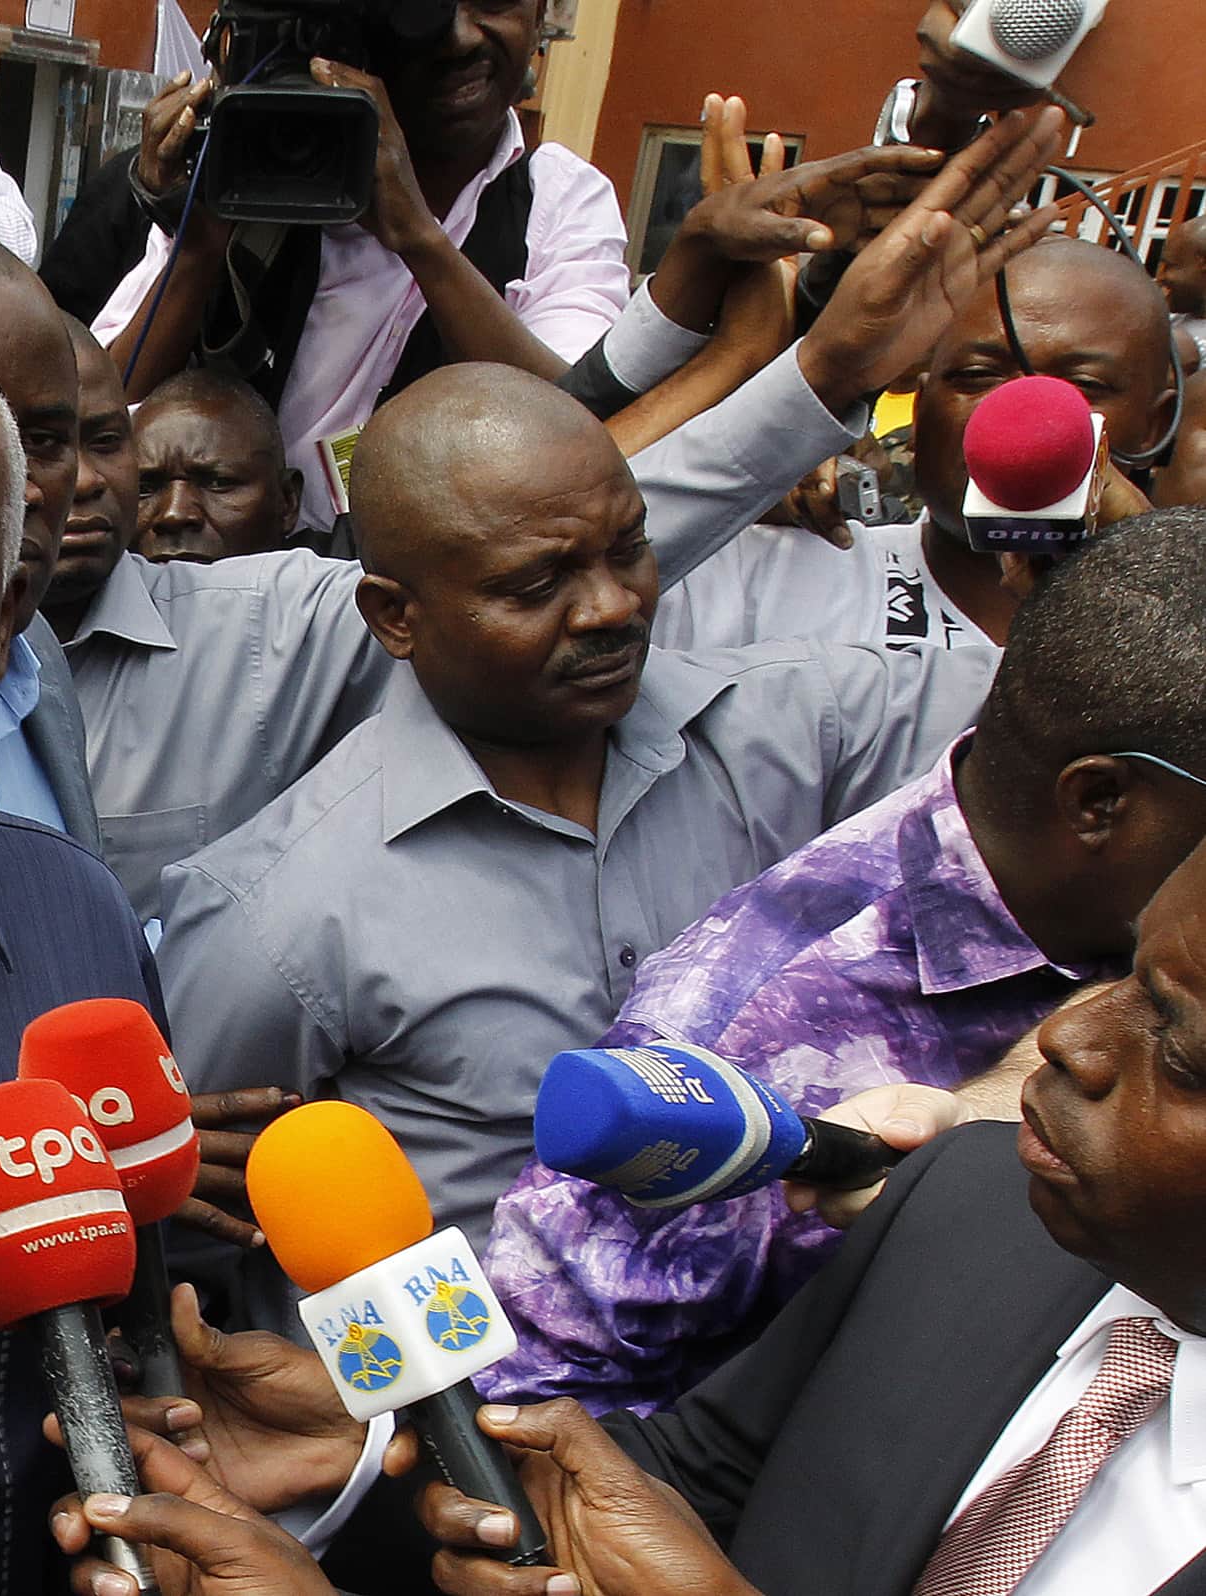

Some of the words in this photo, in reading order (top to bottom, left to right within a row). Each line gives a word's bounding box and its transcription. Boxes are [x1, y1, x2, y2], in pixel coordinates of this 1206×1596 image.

[21, 1222, 128, 1254] www.tpa.ao
[402, 1257, 472, 1306] RNA
[317, 1299, 385, 1347] RNA
